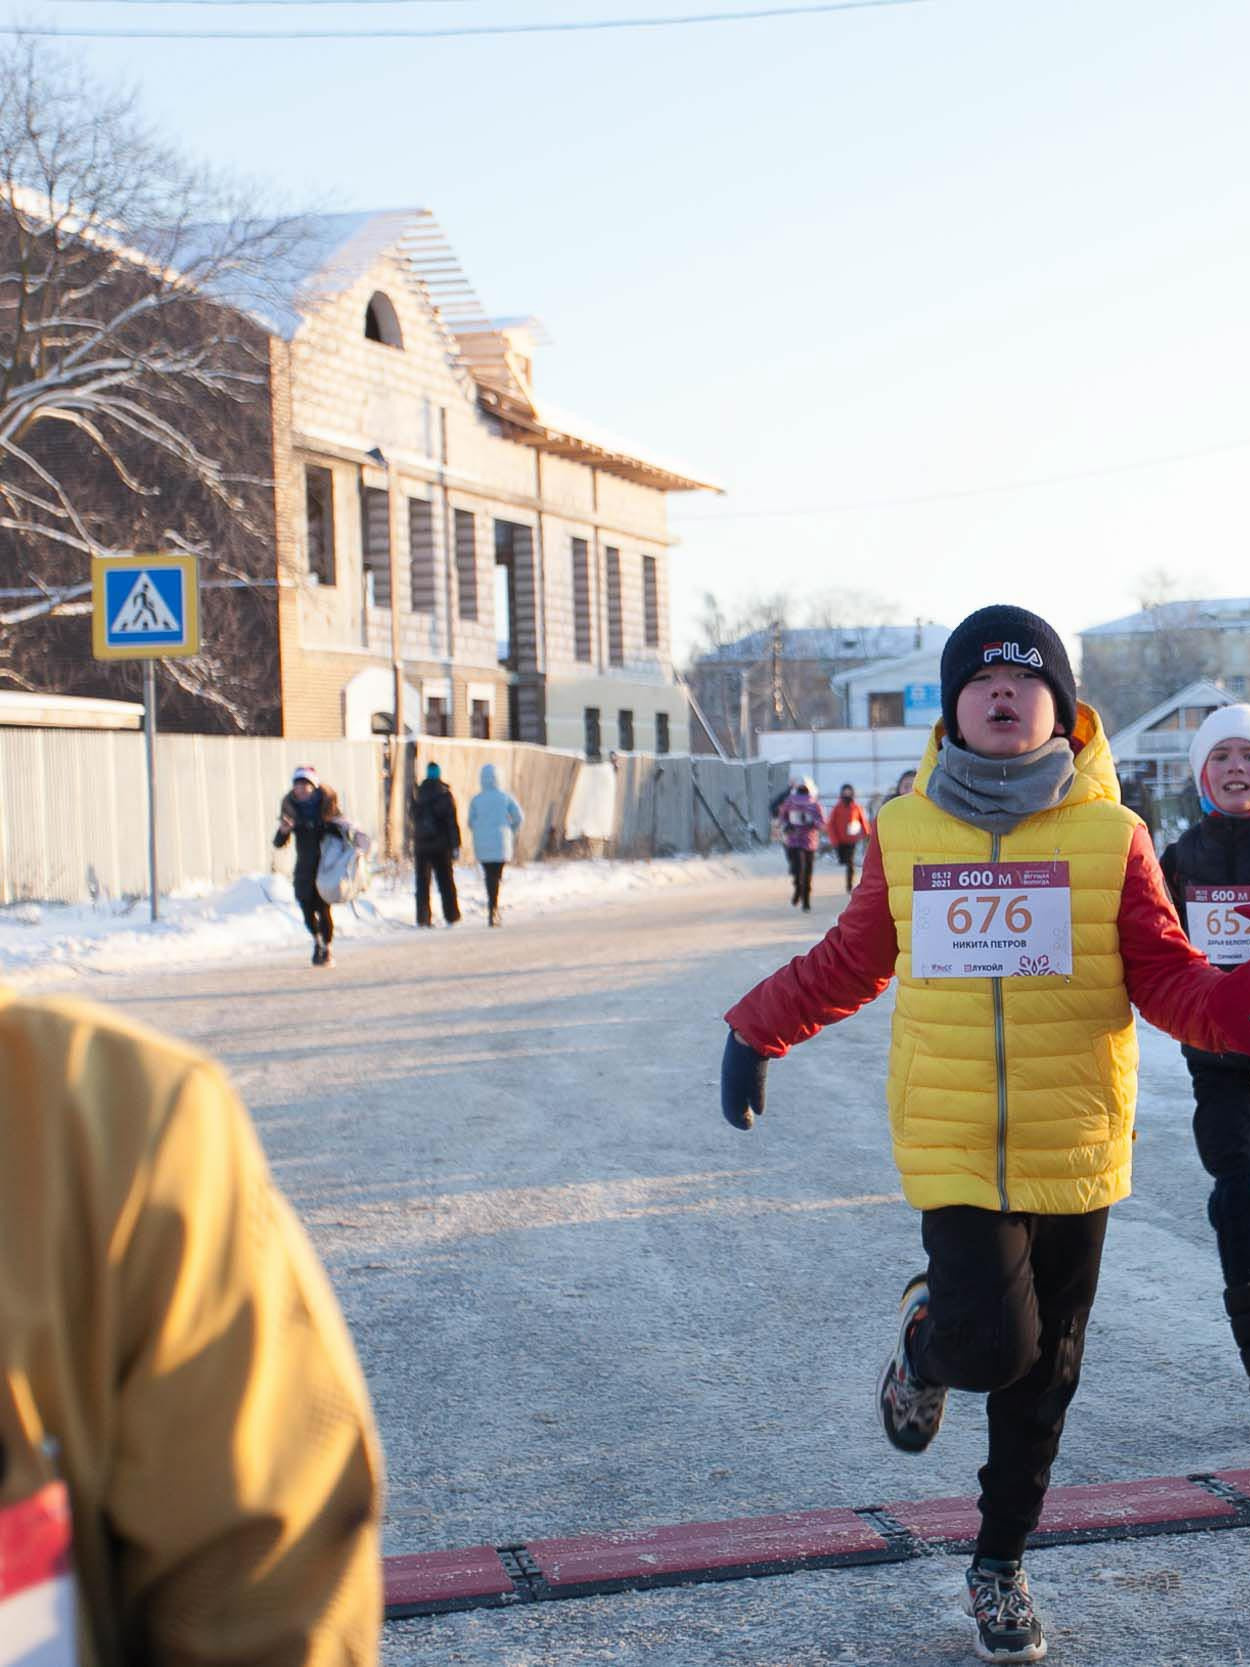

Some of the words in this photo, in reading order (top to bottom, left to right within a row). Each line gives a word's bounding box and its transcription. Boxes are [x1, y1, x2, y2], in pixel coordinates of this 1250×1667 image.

[983, 642, 1043, 667] FILA
[931, 880, 951, 888] 2021
[958, 871, 993, 886] 600
[999, 874, 1012, 885] М
[1211, 891, 1235, 901] 600
[1238, 893, 1248, 901] М
[947, 895, 1033, 934] 676
[952, 939, 989, 950] НИКИТА
[990, 939, 1028, 949] ПЕТРОВ
[971, 962, 1004, 972] ЛУКОЙЛ
